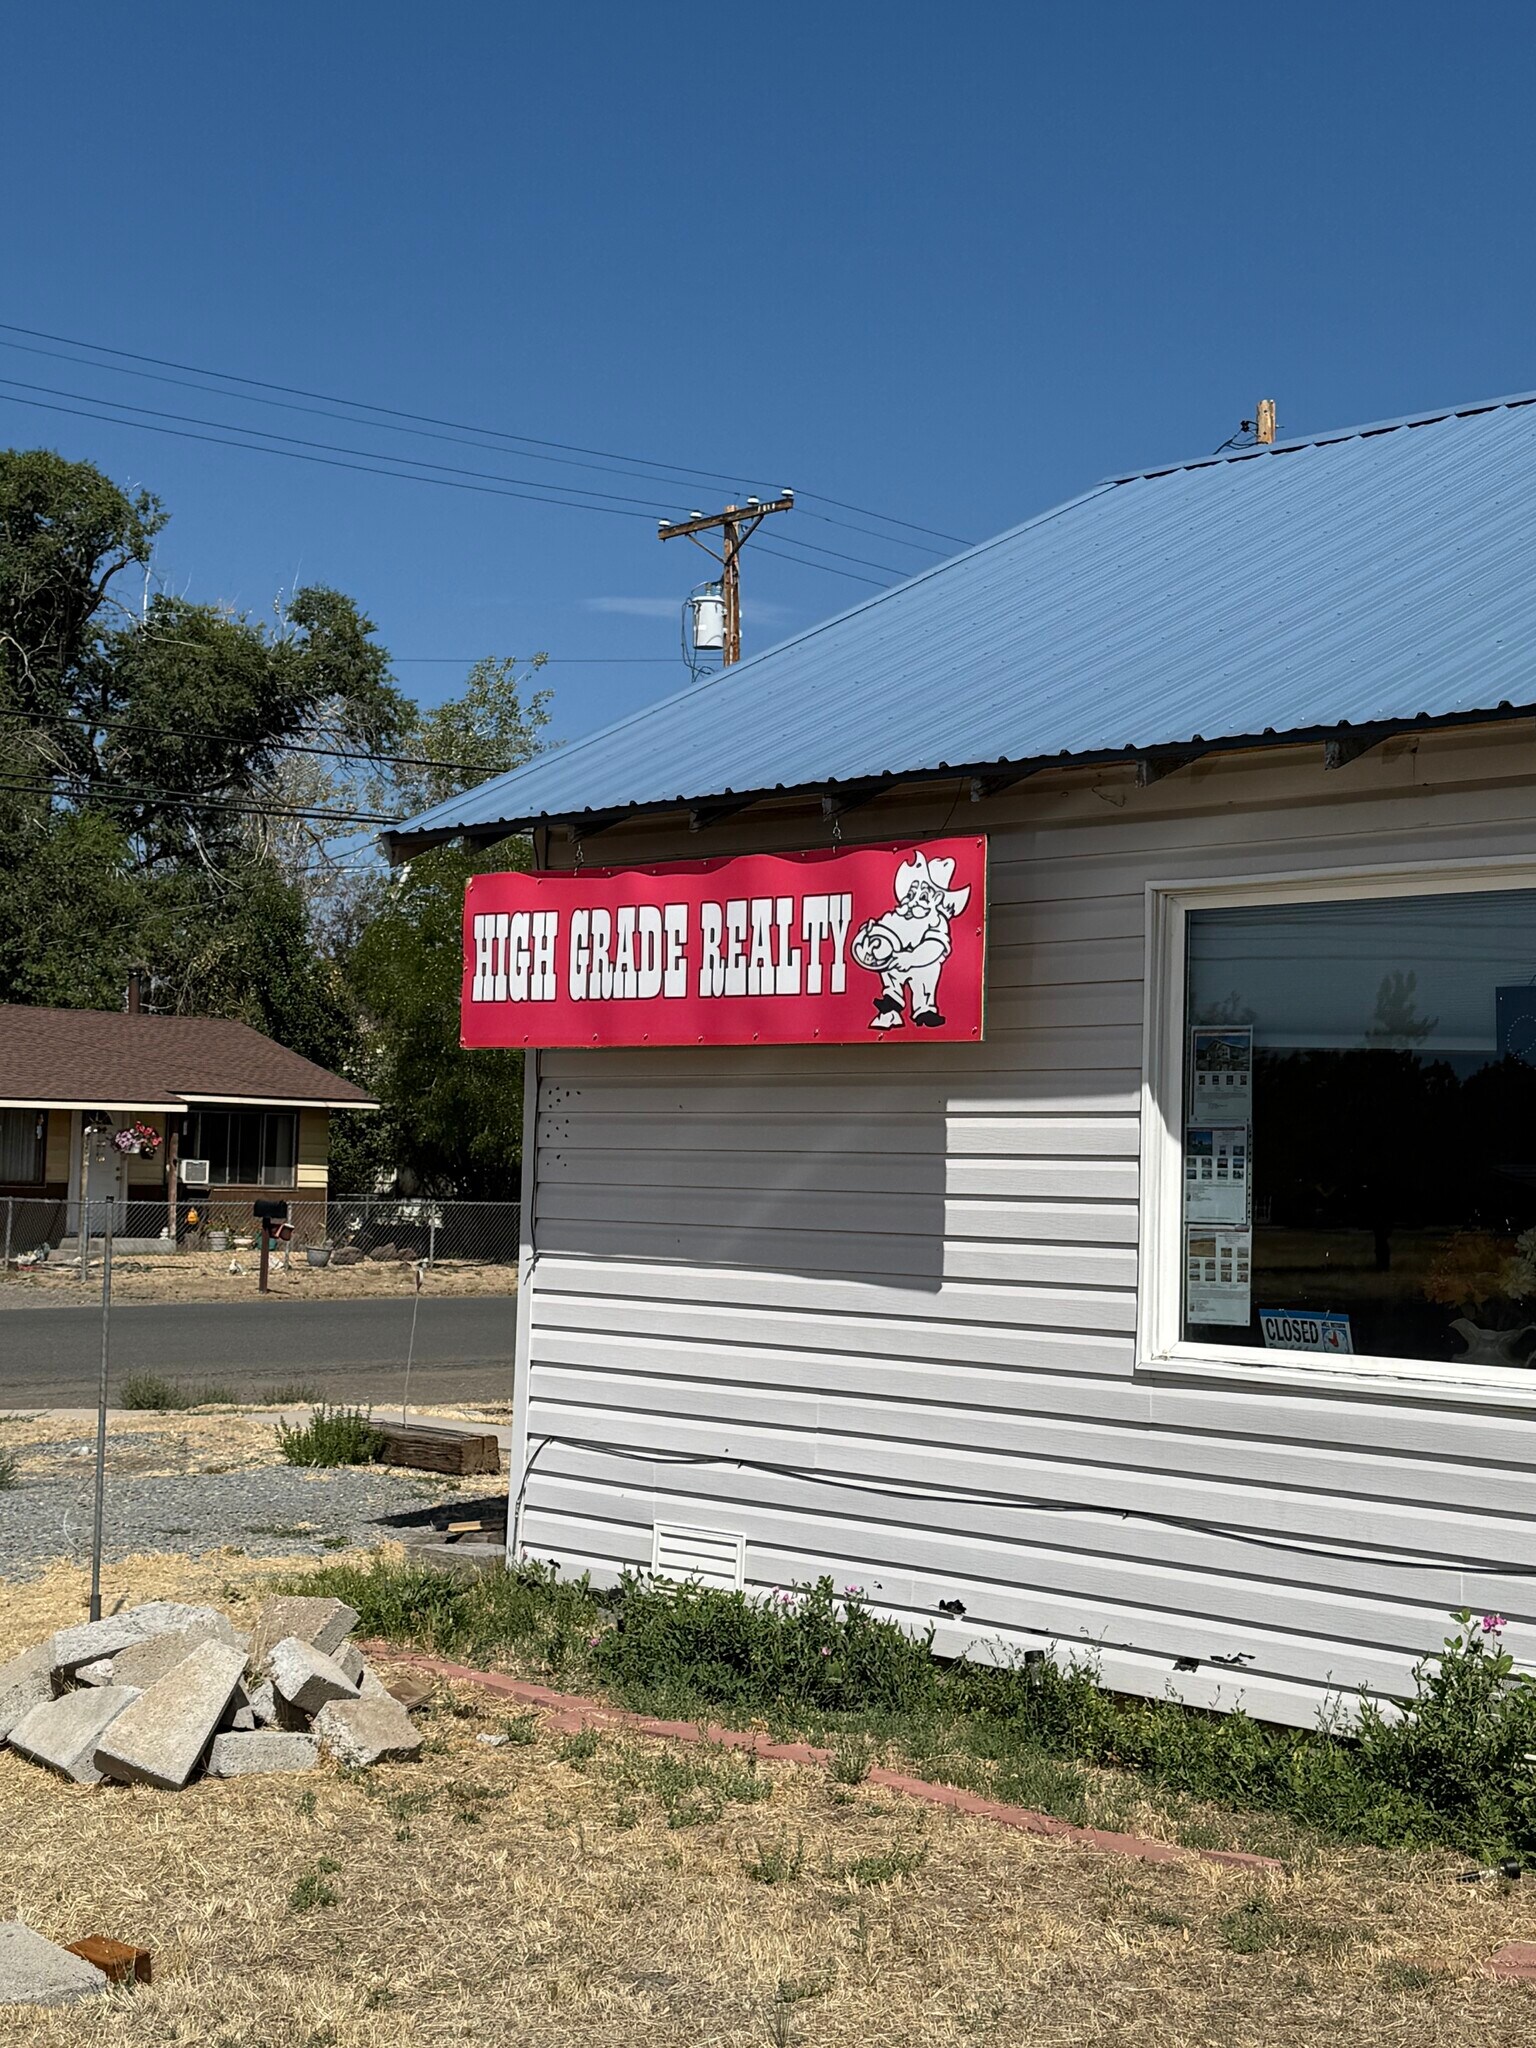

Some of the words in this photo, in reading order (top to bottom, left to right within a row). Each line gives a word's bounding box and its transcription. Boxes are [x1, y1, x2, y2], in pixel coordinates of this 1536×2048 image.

[472, 911, 559, 1002] HIGH
[568, 903, 689, 1001] GRADE
[699, 892, 853, 998] REALTY
[1265, 1317, 1319, 1344] CLOSED
